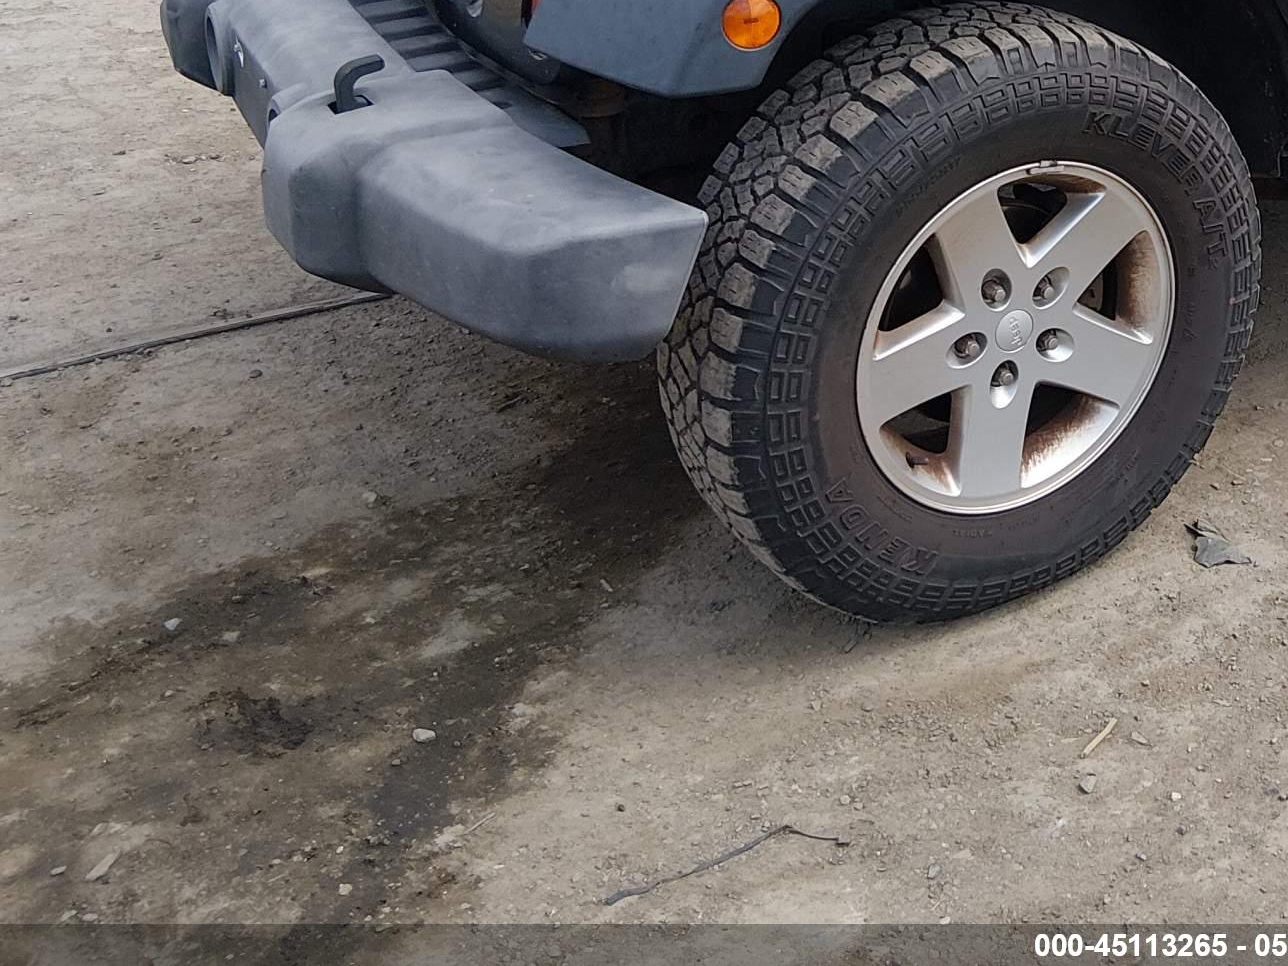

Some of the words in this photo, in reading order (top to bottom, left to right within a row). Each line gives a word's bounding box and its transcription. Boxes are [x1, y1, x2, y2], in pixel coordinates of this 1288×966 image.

[1083, 111, 1204, 196] KLEVER
[1008, 316, 1023, 346] Jeep
[825, 477, 938, 575] KENDA
